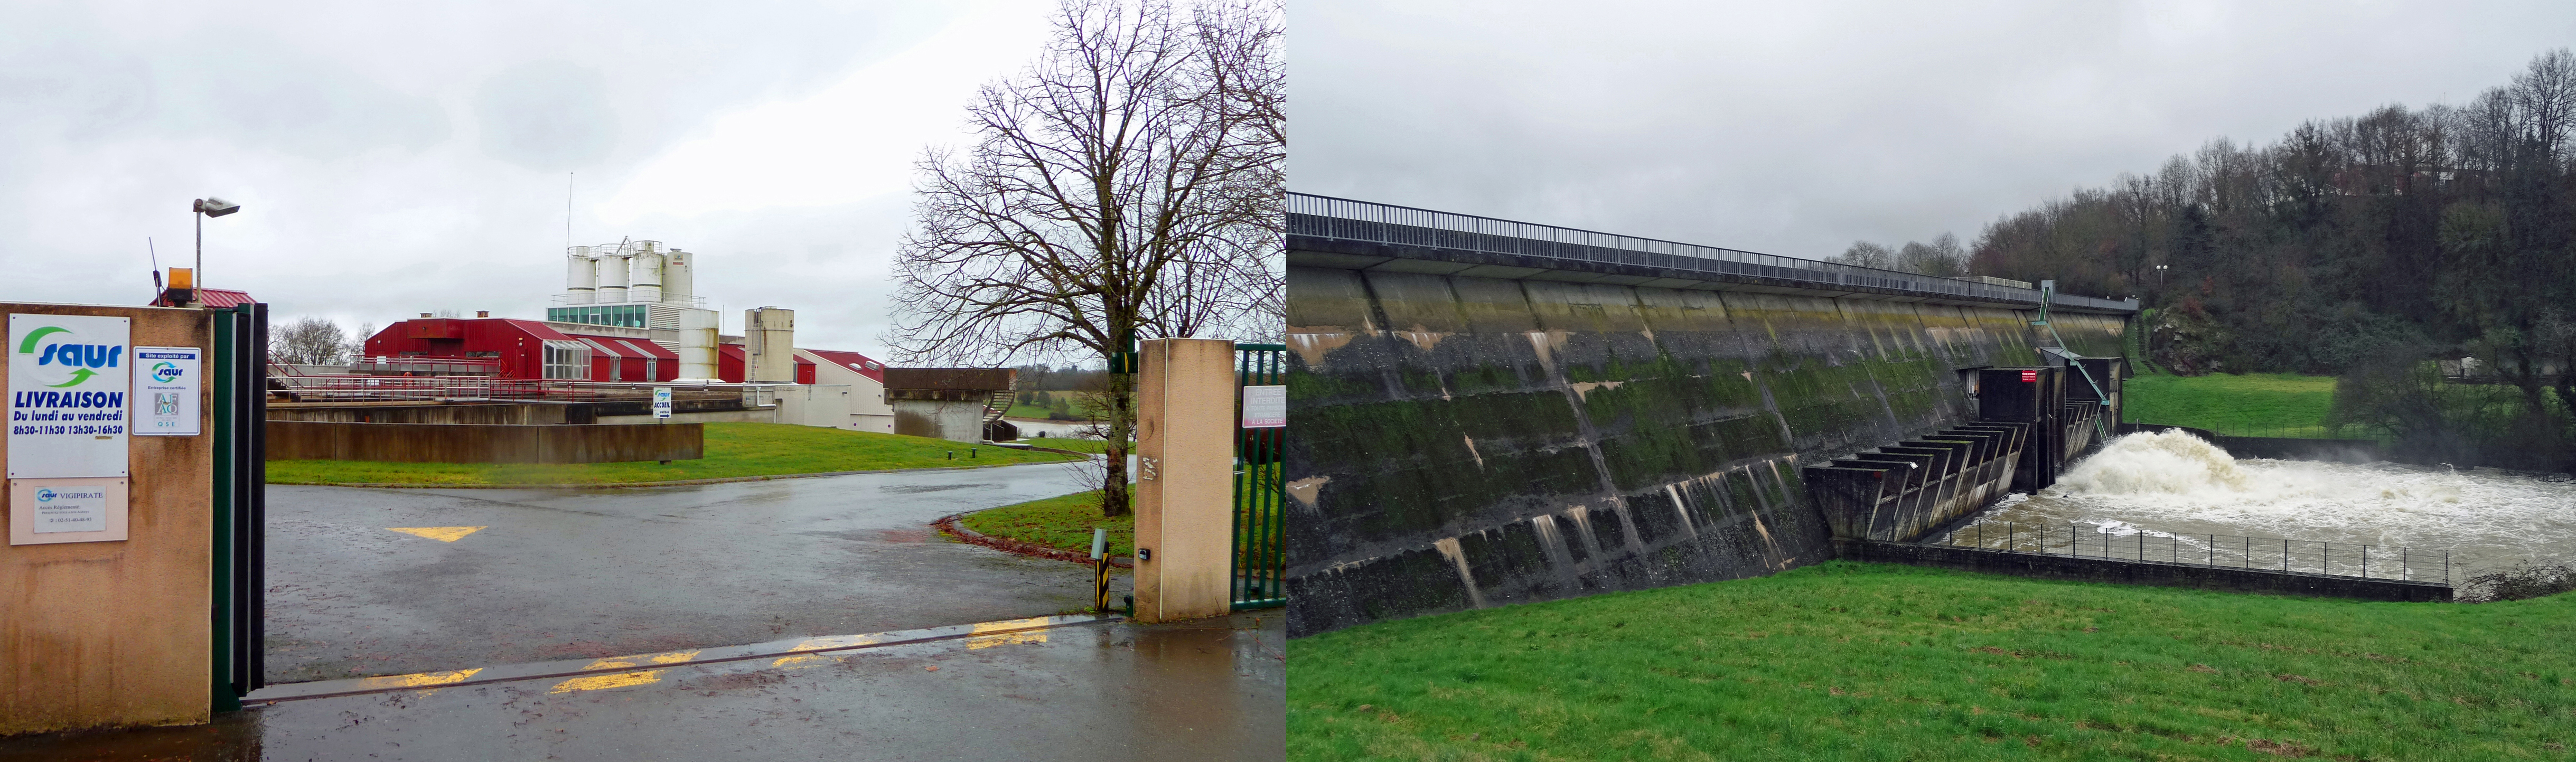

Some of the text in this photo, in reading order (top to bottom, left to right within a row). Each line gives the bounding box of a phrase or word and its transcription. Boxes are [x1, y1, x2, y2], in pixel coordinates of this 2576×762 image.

[39, 343, 122, 368] saur
[15, 391, 124, 408] LIVRAISON
[14, 411, 28, 421] Du
[31, 410, 59, 421] lundi
[78, 410, 123, 421] vendredi
[14, 425, 123, 435] 8h30-11h30 13h30-16h30
